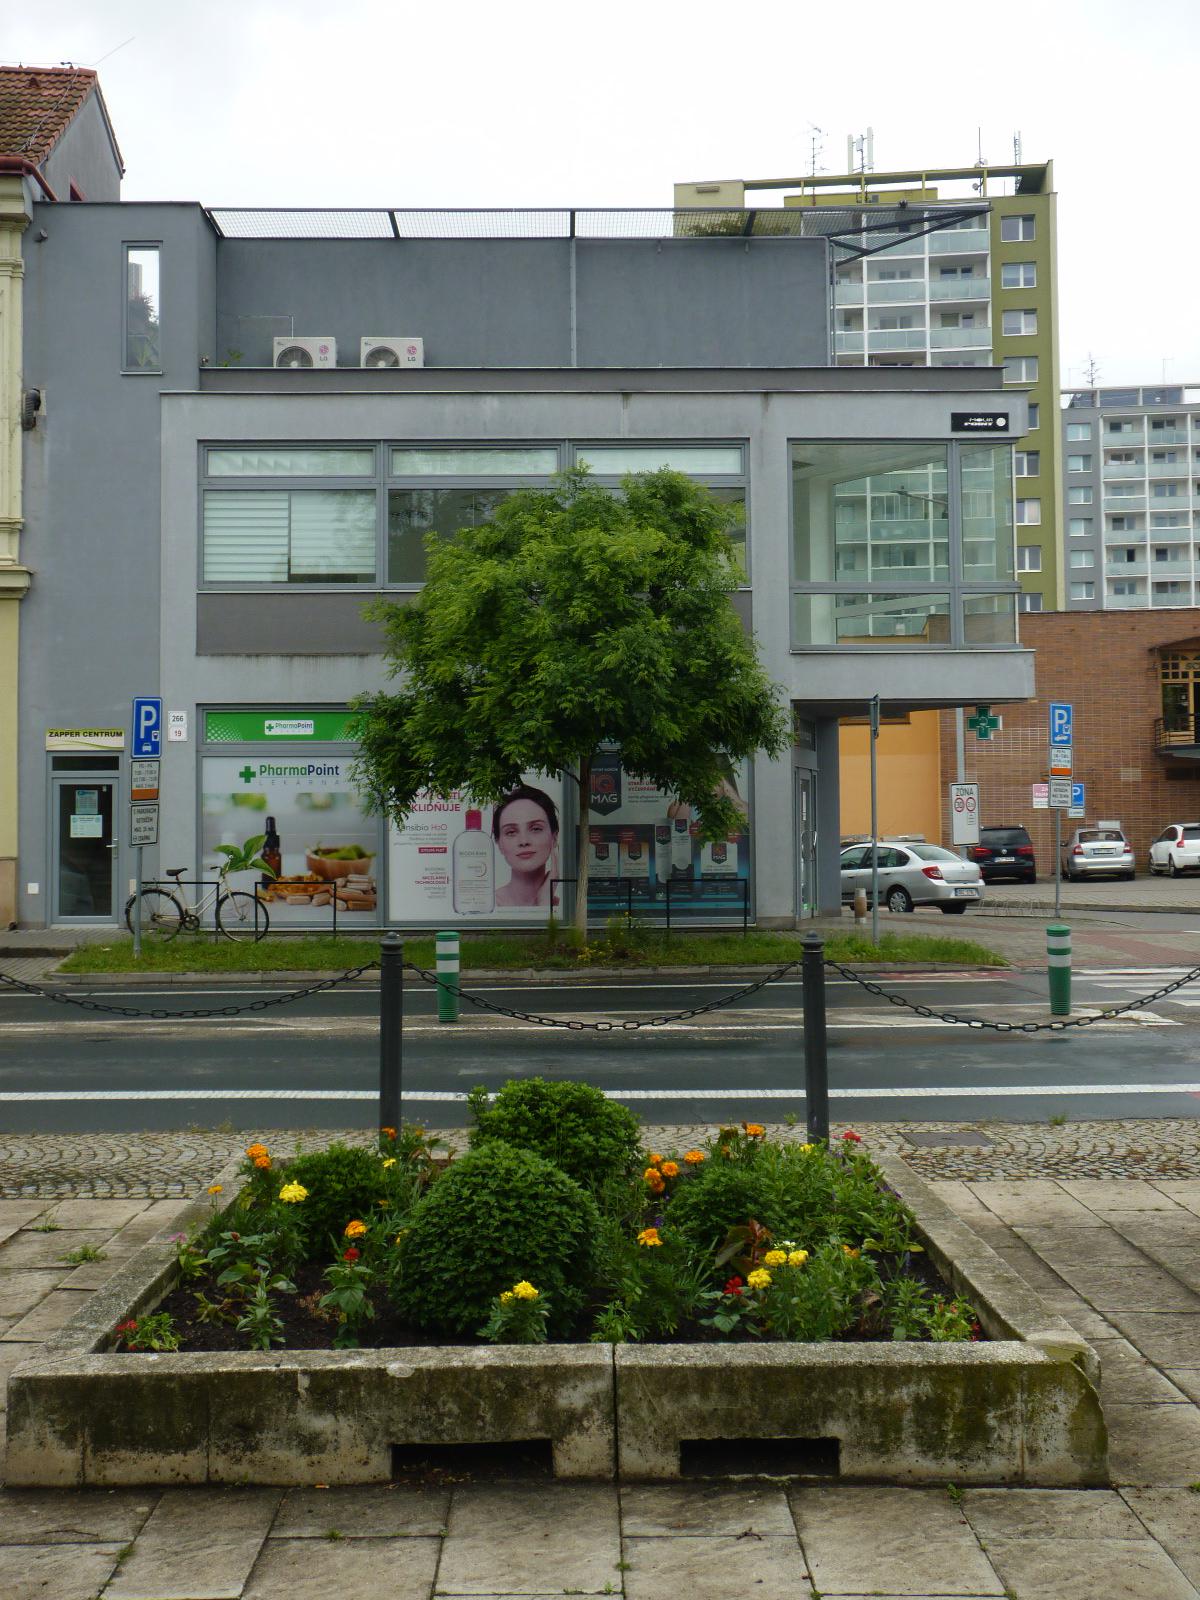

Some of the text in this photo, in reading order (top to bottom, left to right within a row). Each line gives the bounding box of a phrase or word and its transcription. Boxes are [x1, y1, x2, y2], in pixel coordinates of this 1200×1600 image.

[275, 722, 313, 730] PharmaPoint
[259, 764, 340, 776] PharmaPoint
[956, 787, 974, 796] ZONA
[591, 794, 618, 803] MAG
